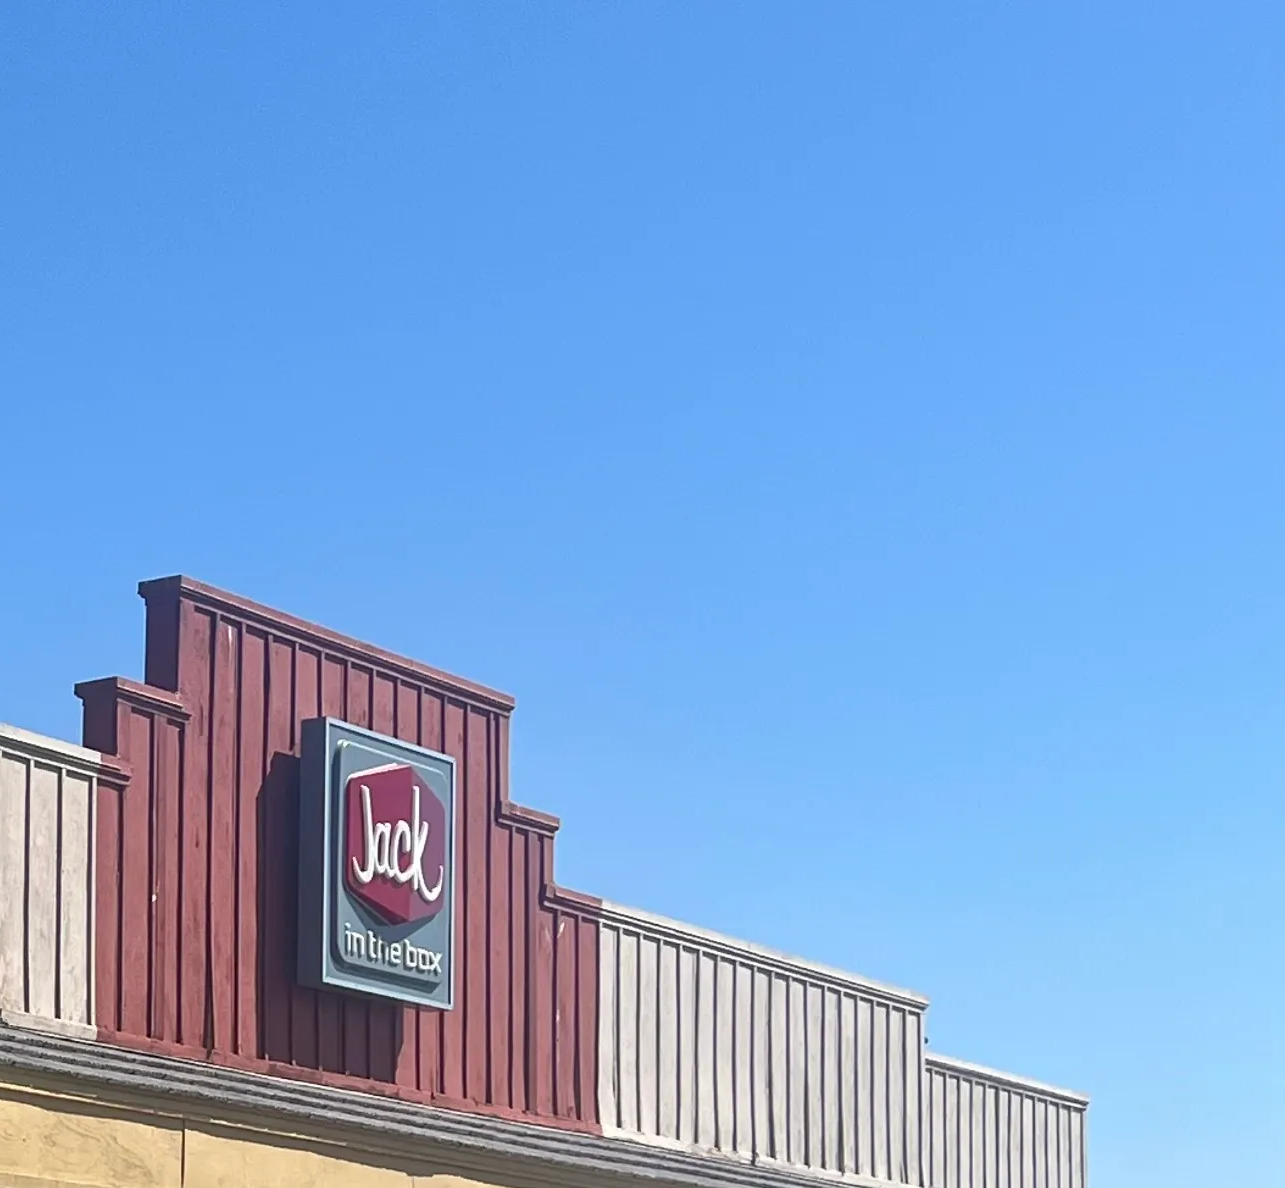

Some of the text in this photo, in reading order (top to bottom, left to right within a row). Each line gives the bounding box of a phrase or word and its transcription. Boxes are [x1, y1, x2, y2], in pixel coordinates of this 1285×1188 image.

[351, 784, 444, 902] Jack
[343, 922, 443, 973] in the box
